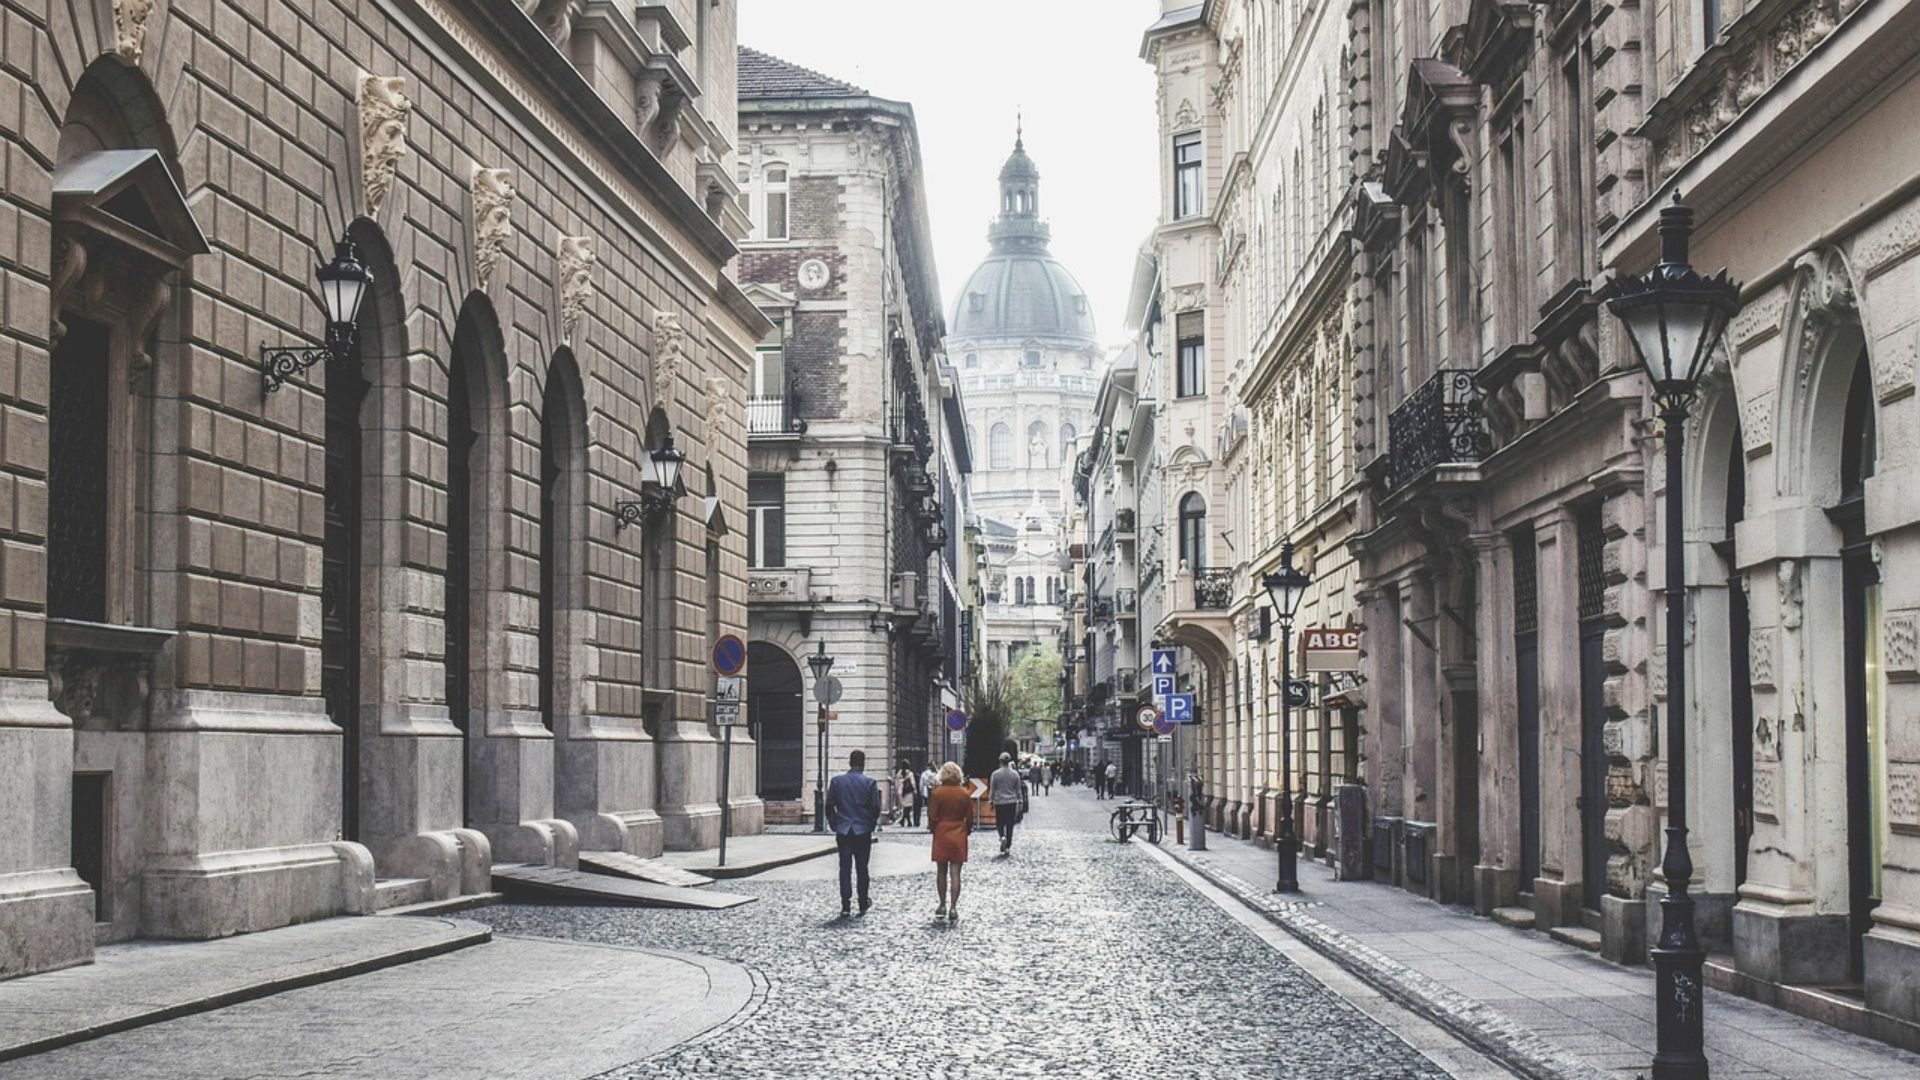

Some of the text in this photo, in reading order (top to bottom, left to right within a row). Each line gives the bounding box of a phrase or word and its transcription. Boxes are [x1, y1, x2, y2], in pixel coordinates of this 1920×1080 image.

[1307, 632, 1358, 648] ABC
[1158, 678, 1170, 693] P
[1171, 698, 1186, 719] P
